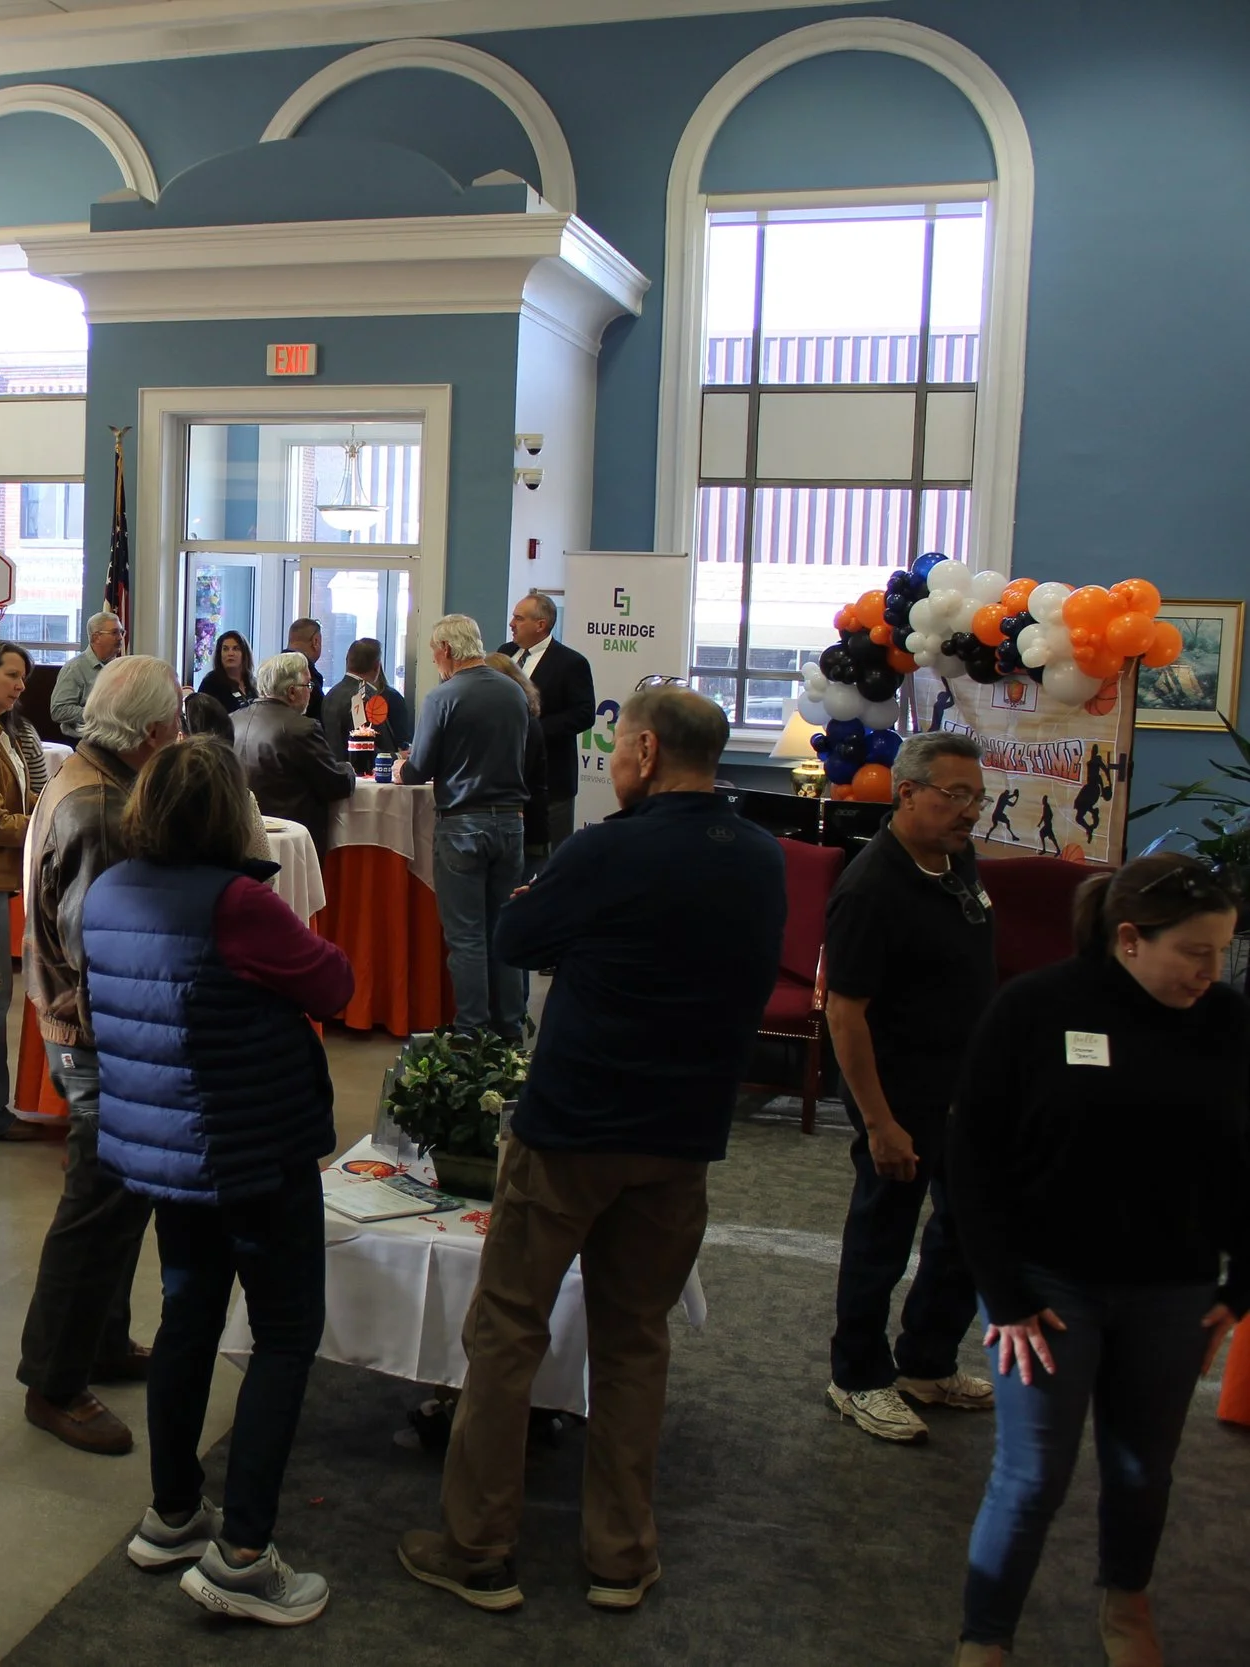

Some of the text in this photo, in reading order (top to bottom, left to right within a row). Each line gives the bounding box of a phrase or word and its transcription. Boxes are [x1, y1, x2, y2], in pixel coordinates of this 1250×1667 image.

[275, 345, 309, 374] EXIT
[587, 622, 655, 638] BLUE RIDGE
[603, 639, 637, 653] BANK
[980, 735, 1083, 782] GAME TIME
[834, 808, 860, 817] acer
[201, 1586, 229, 1611] topo
